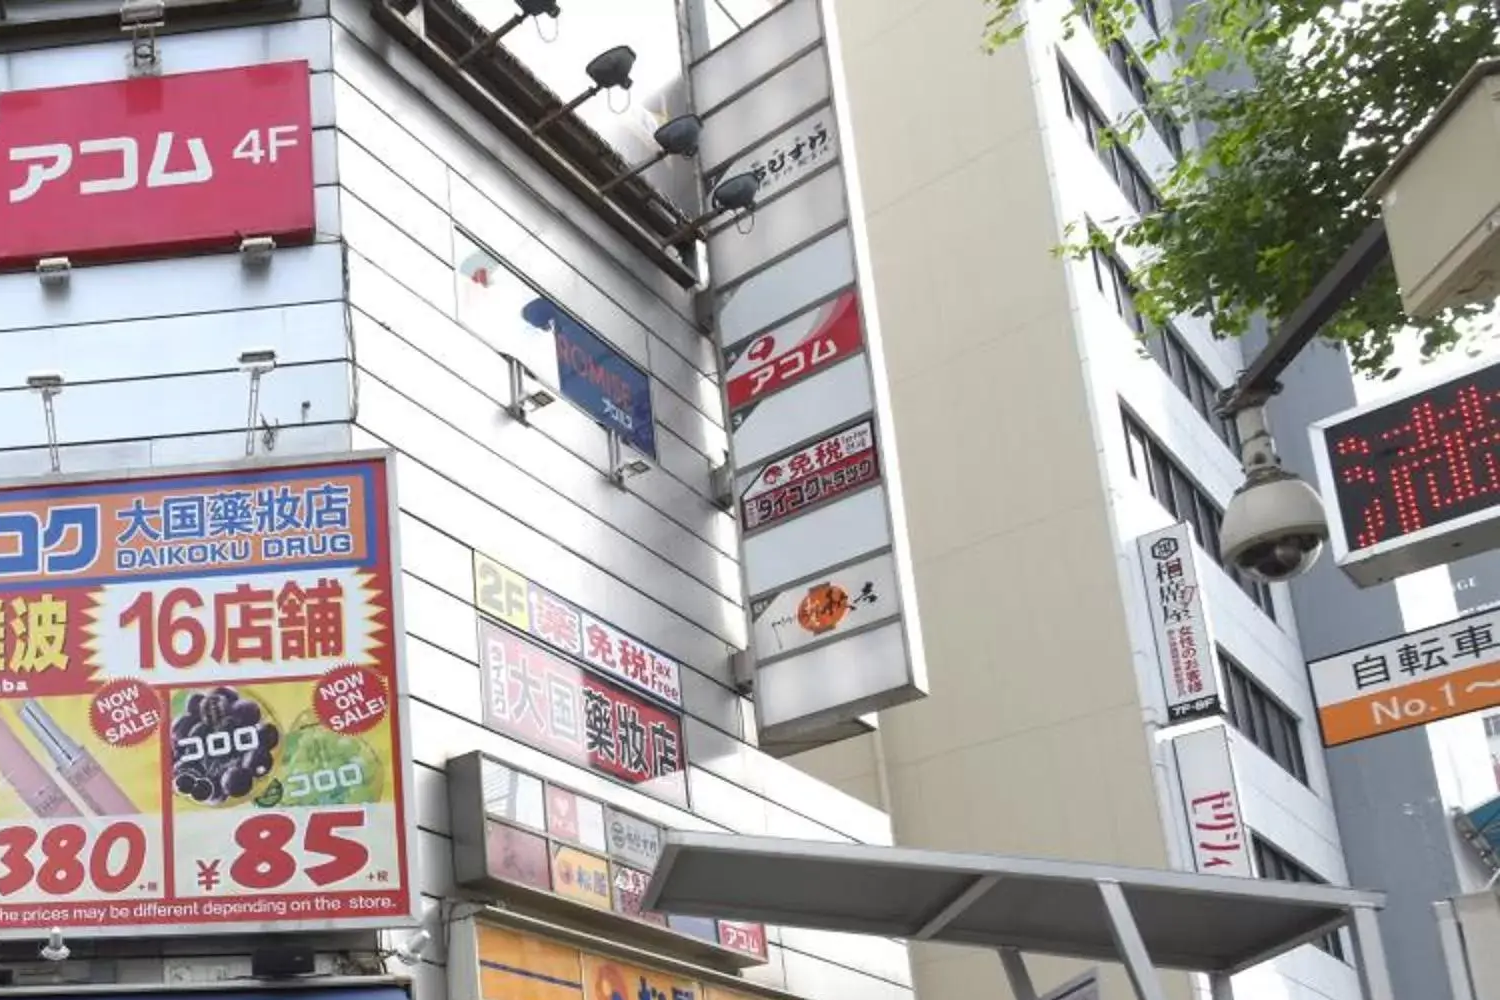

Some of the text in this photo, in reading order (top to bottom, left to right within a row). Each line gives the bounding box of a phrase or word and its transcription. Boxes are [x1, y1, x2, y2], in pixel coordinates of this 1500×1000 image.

[8, 125, 299, 204] アコム 4F
[748, 337, 838, 395] アコム
[788, 436, 843, 481] 免税
[116, 532, 353, 570] DAIKOKU DRUG
[479, 562, 526, 618] 2F
[118, 577, 344, 670] 16店舗
[586, 623, 650, 686] 免税
[1352, 622, 1500, 691] 自転車
[96, 685, 140, 713] NOW
[319, 671, 365, 701] NOW
[335, 690, 365, 710] ON
[105, 710, 161, 744] SALE!
[110, 702, 140, 722] ON
[330, 696, 386, 731] SALE!
[195, 810, 370, 891] ¥85
[22, 907, 70, 925] prices
[73, 907, 108, 923] may
[110, 904, 130, 919] be
[133, 901, 199, 918] different
[202, 898, 287, 918] depending
[291, 900, 311, 914] on
[314, 896, 341, 912] the
[349, 895, 397, 910] store.
[724, 925, 760, 954] アコム
